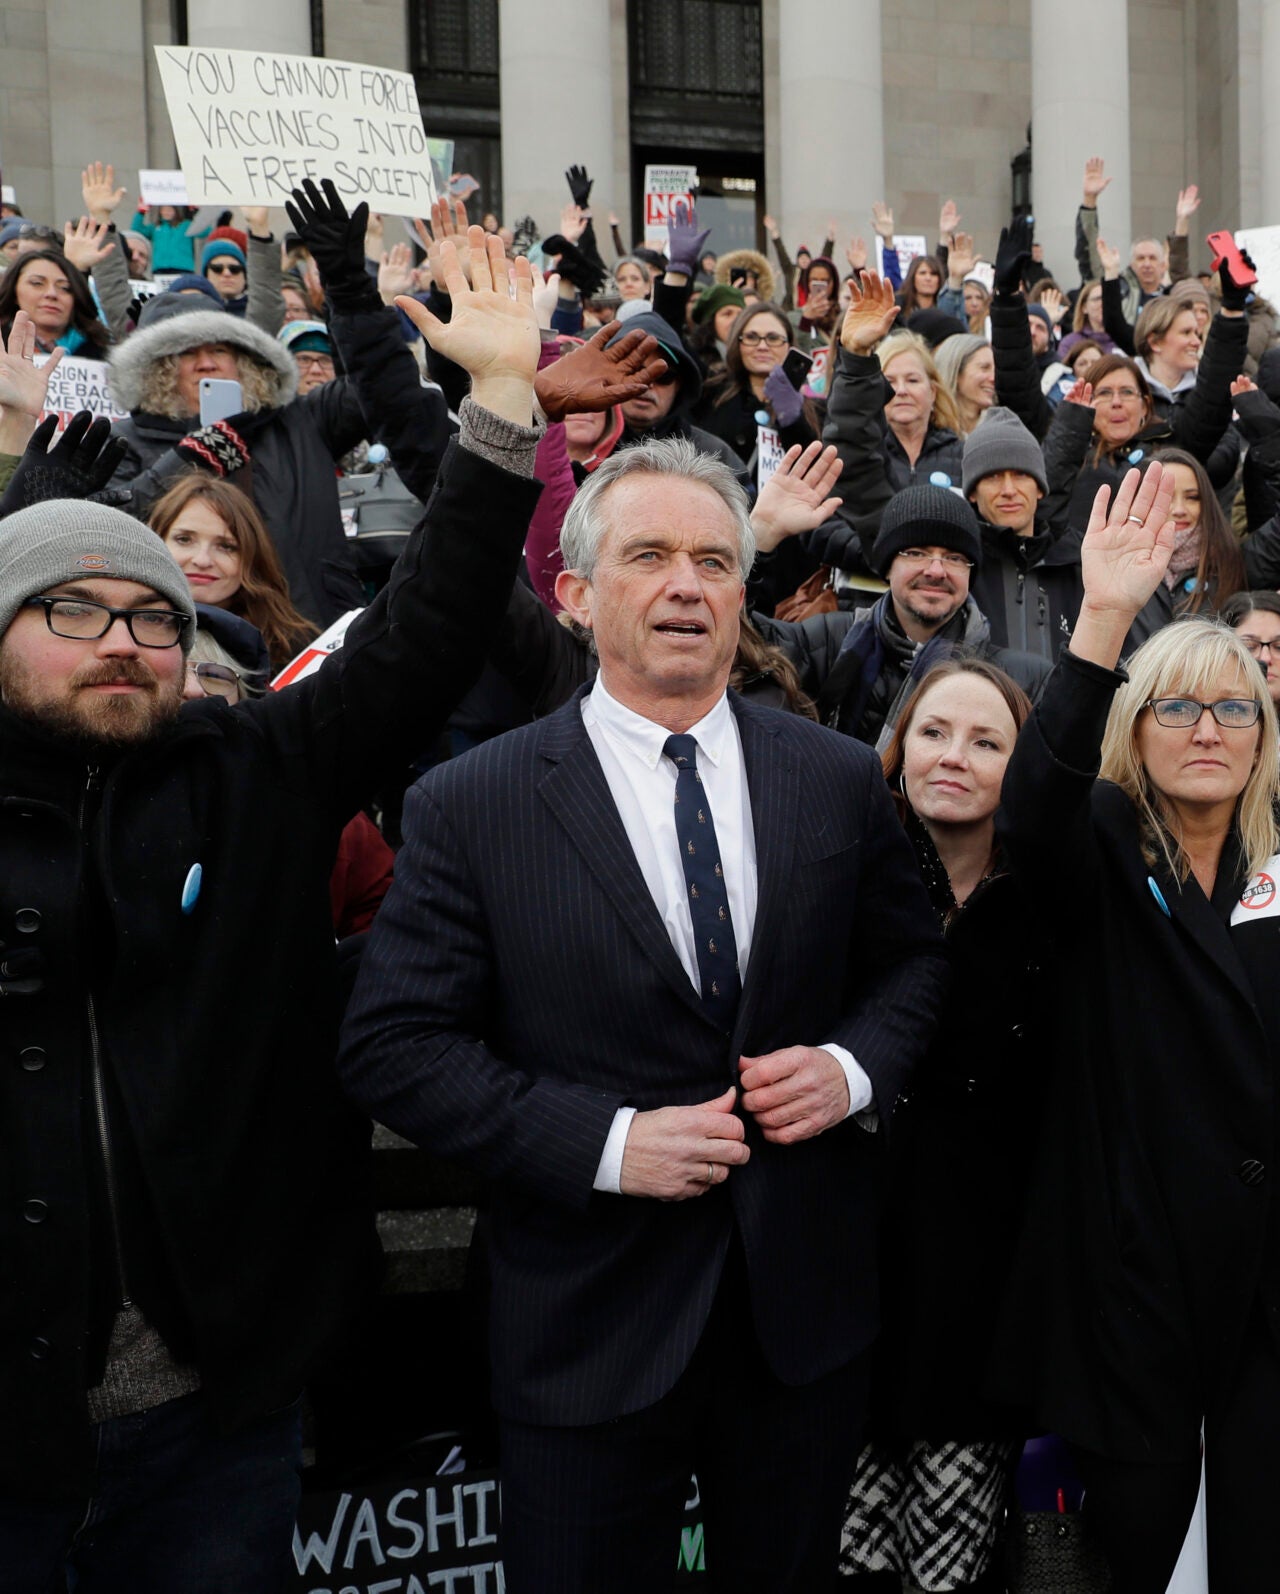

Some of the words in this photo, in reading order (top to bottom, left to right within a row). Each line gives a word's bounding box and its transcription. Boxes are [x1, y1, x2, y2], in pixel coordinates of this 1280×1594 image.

[164, 50, 235, 95] YOU
[253, 56, 351, 101] CANNOT
[360, 70, 420, 115] FORCE
[187, 102, 339, 151] VACCINES
[353, 118, 425, 156] INTO
[202, 154, 232, 197] A
[334, 161, 433, 203] SOCIETY
[1253, 882, 1273, 895] 1638
[291, 1480, 503, 1576] WASHI
